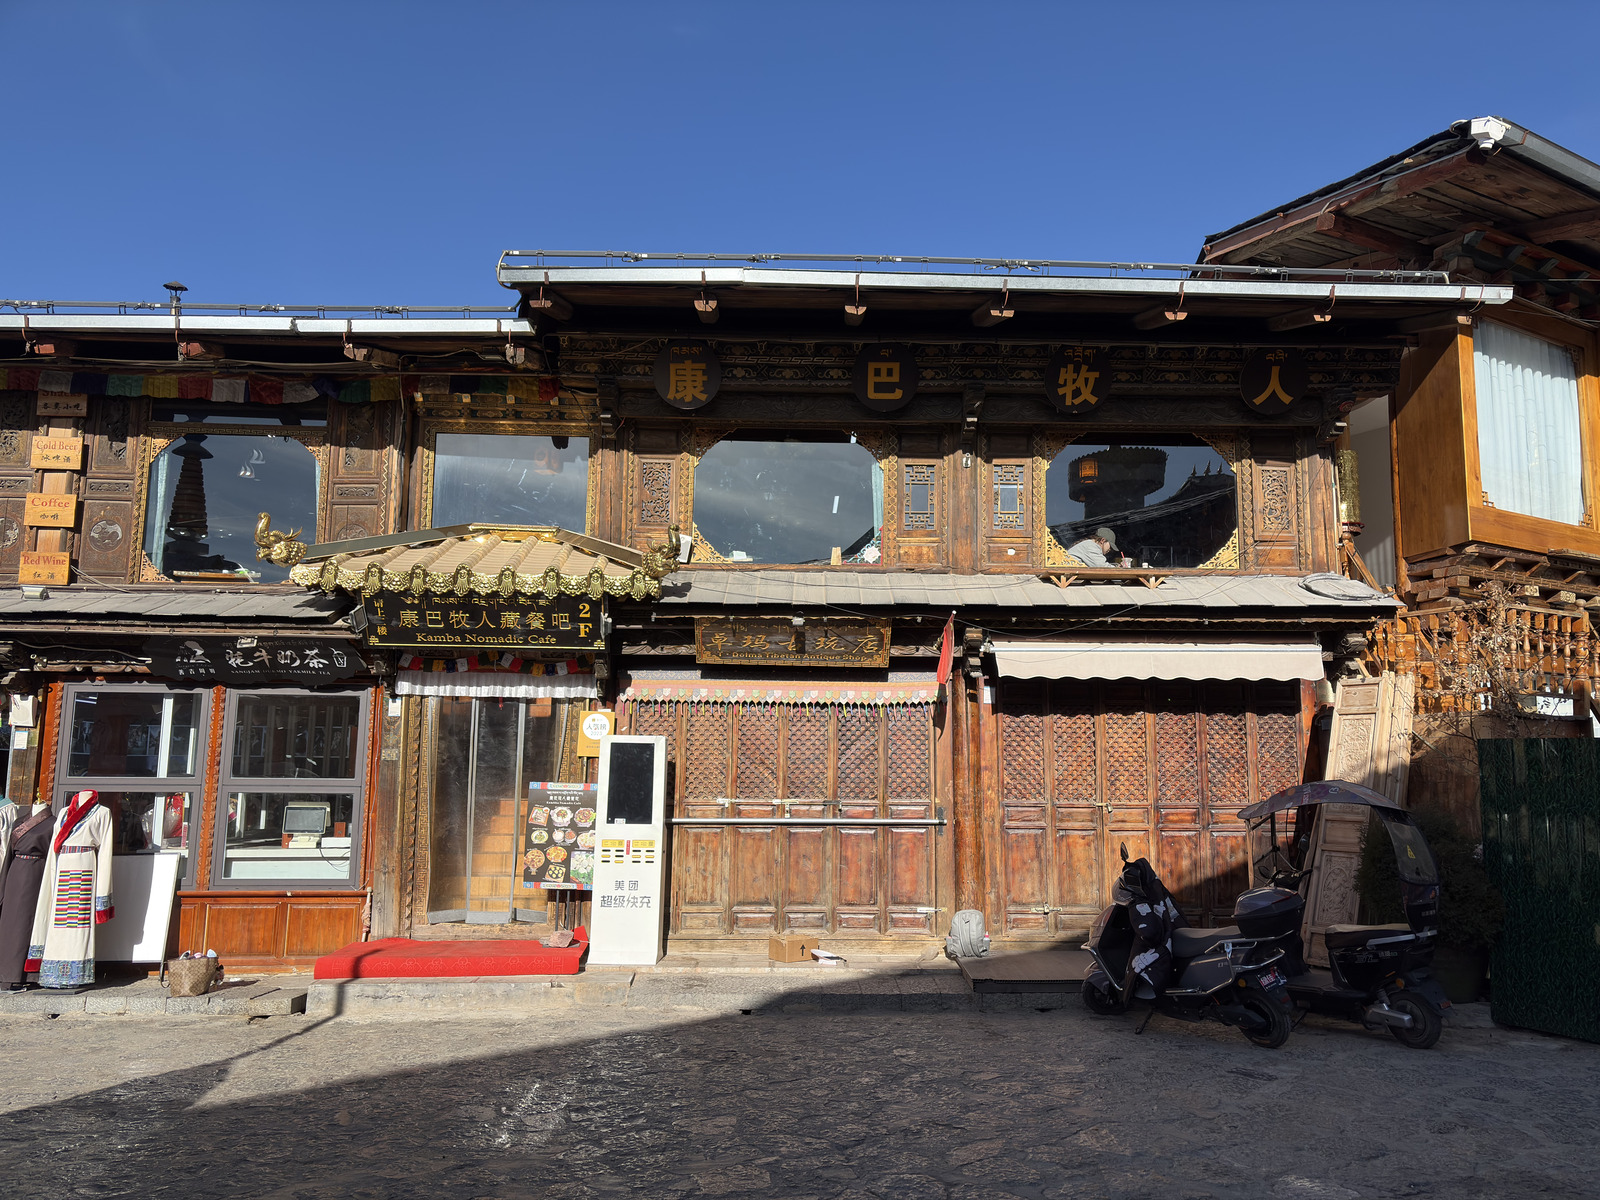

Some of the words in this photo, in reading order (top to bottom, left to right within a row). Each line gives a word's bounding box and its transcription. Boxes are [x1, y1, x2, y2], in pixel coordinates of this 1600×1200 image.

[667, 360, 708, 402] 康
[867, 361, 903, 400] 巴
[1057, 364, 1100, 405] 牧
[1252, 365, 1294, 405] 人
[36, 441, 57, 450] Cold
[59, 441, 78, 451] Beer
[31, 497, 70, 508] Coffee
[23, 555, 41, 565] Red
[42, 556, 66, 565] Wine
[33, 571, 55, 580] 红酒
[373, 598, 388, 636] 请上二楼
[398, 609, 572, 631] 康巴牧人藏餐吧
[416, 633, 461, 643] Kamba
[465, 633, 525, 644] Nomadic
[527, 634, 557, 644] Cafe
[803, 653, 841, 661] Antique
[842, 653, 867, 662] Shop
[614, 880, 639, 891] 美团
[600, 893, 651, 909] 超级快充
